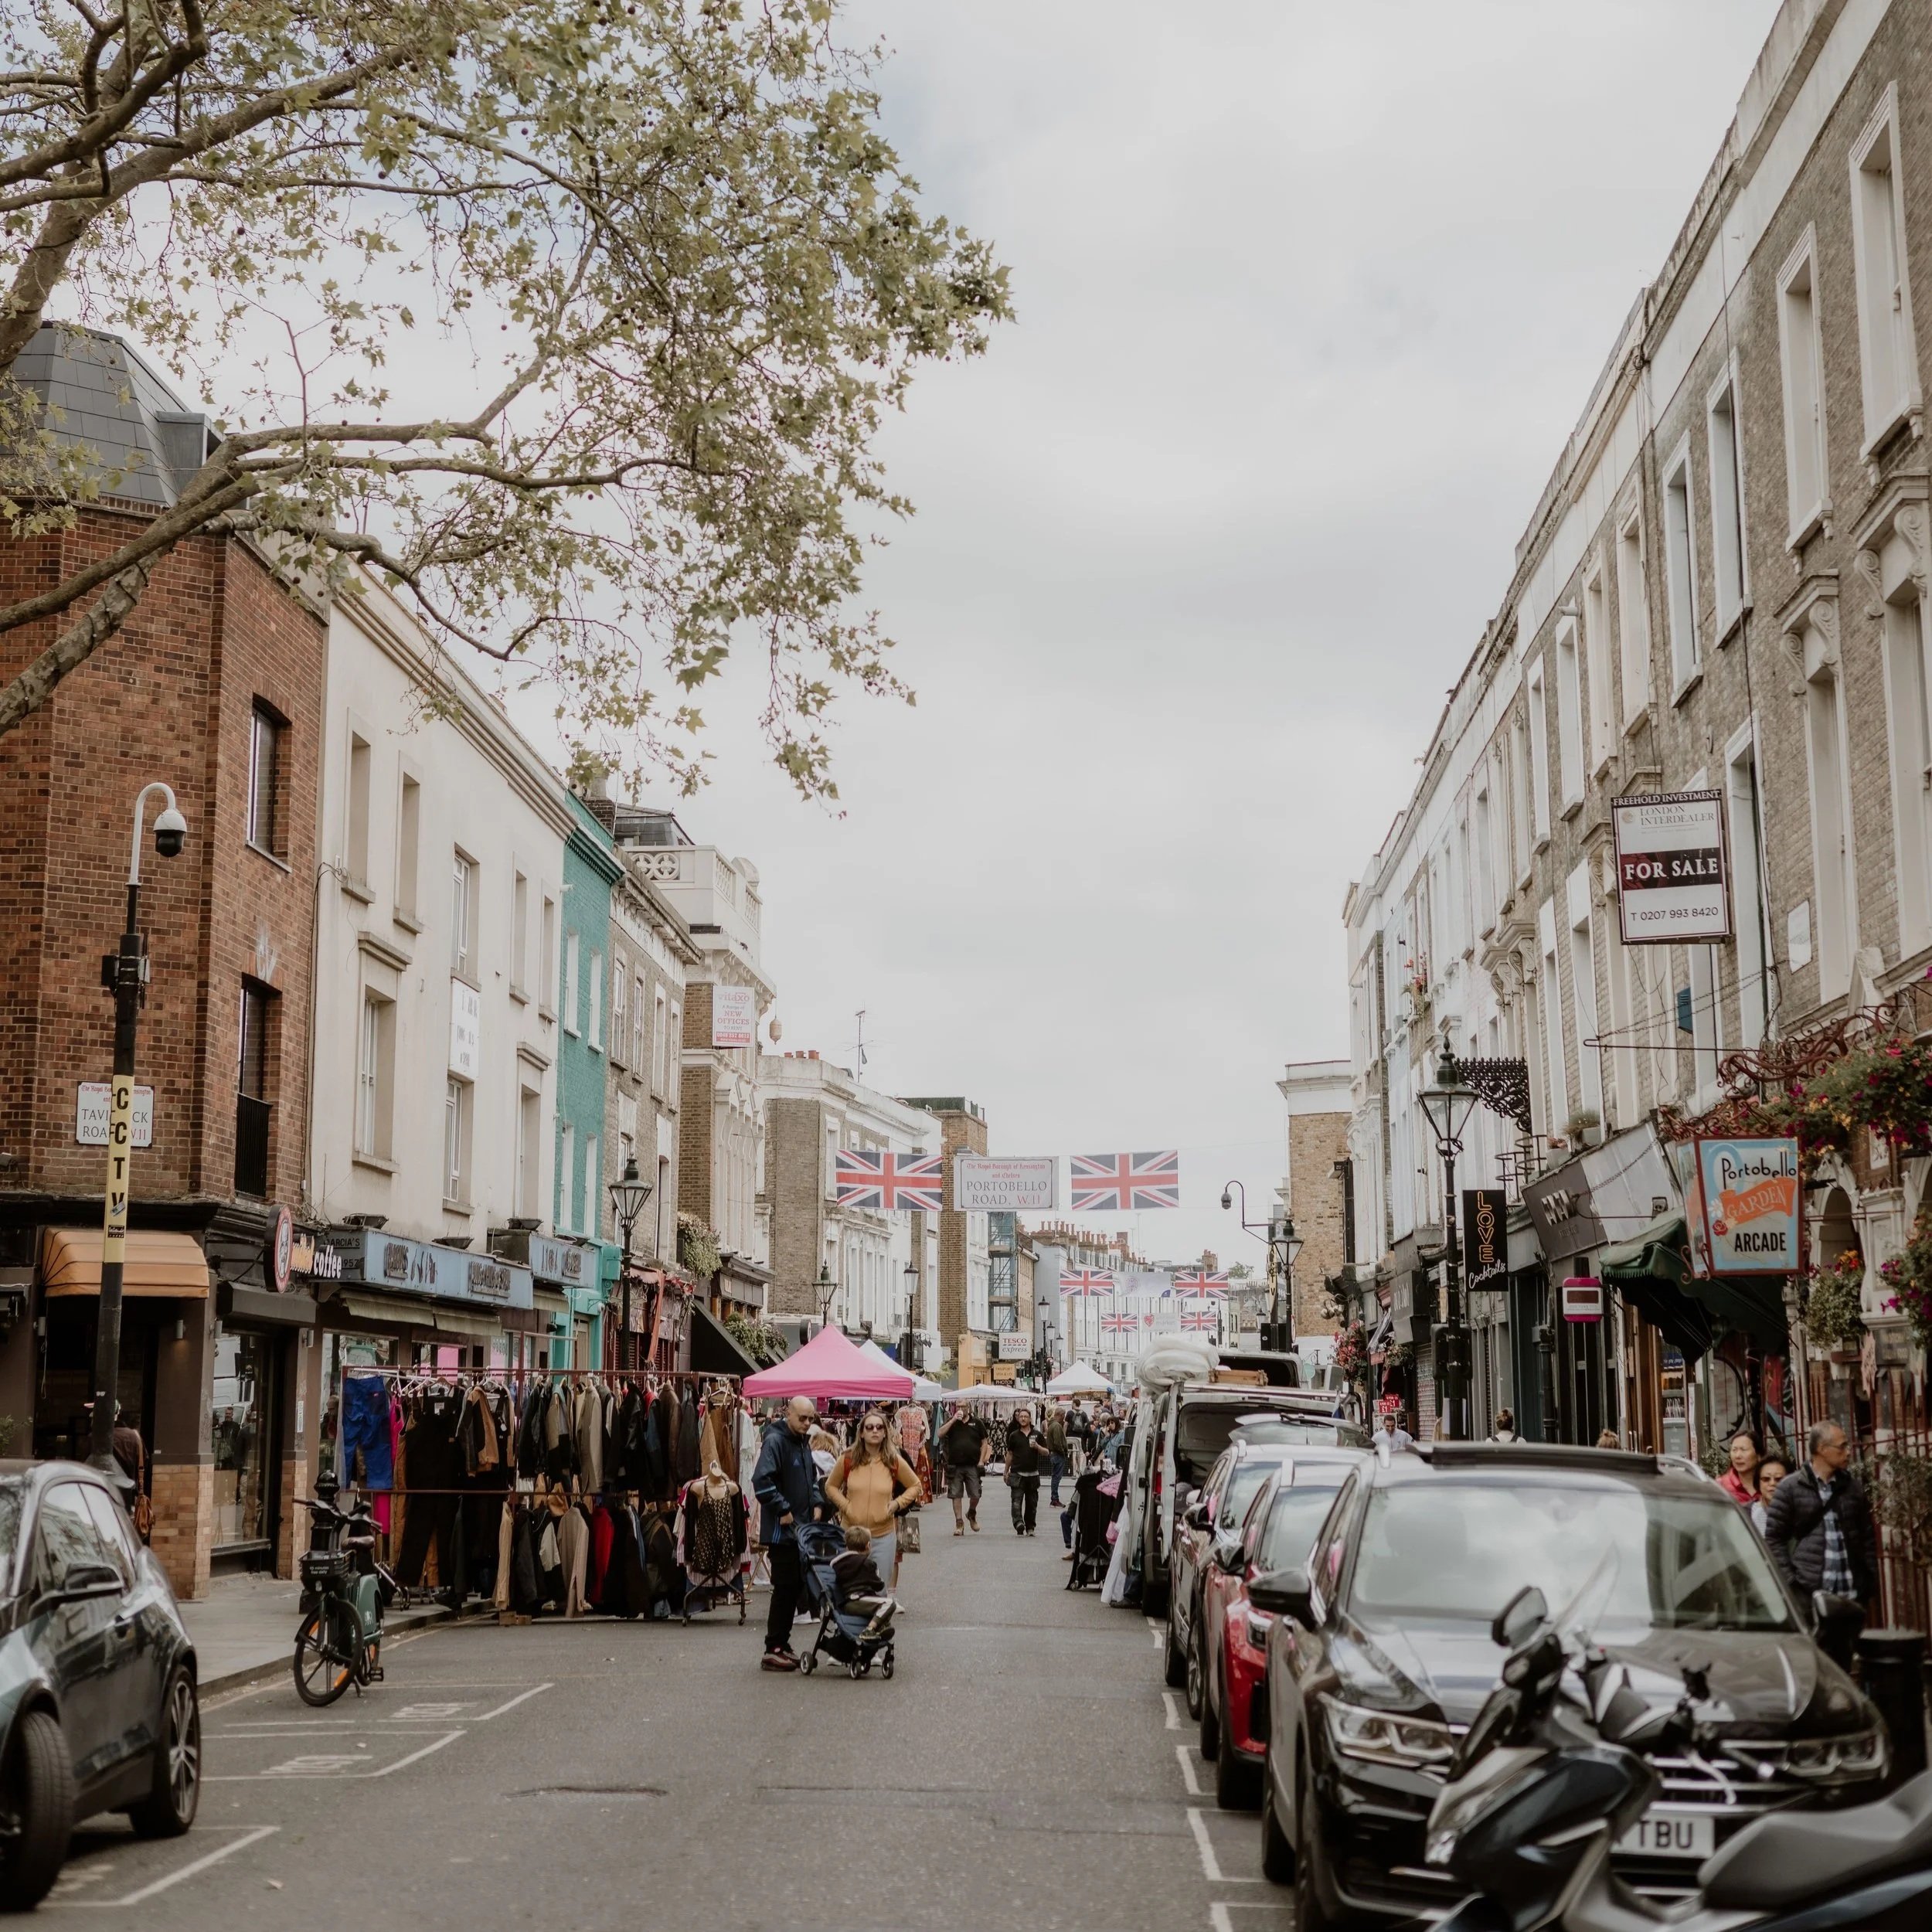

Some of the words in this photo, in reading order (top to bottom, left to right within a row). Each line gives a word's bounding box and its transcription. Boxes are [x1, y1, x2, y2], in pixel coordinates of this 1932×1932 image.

[1613, 796, 1660, 806] FREEHOLD
[1662, 791, 1719, 802] INVESTMENT
[1640, 804, 1685, 816] LONDON
[1641, 813, 1714, 826] INTERDEALER
[1624, 862, 1667, 880] FOR
[1672, 858, 1719, 877] SALE
[1631, 913, 1637, 921] T
[1640, 910, 1666, 921] 0207
[1669, 909, 1689, 919] 993
[1692, 906, 1719, 917] 8420
[81, 1108, 148, 1123] TAVICK
[83, 1126, 111, 1138] ROA
[1722, 1151, 1797, 1189] Portobello
[967, 1181, 1047, 1192] PORTOBELLO
[1727, 1185, 1787, 1218] GARDEN
[1477, 1191, 1495, 1263] LOVE
[1734, 1232, 1787, 1253] ARCADE
[313, 1244, 342, 1279] coffee
[1468, 1259, 1506, 1289] Cocktails
[1640, 1820, 1693, 1849] TBU
